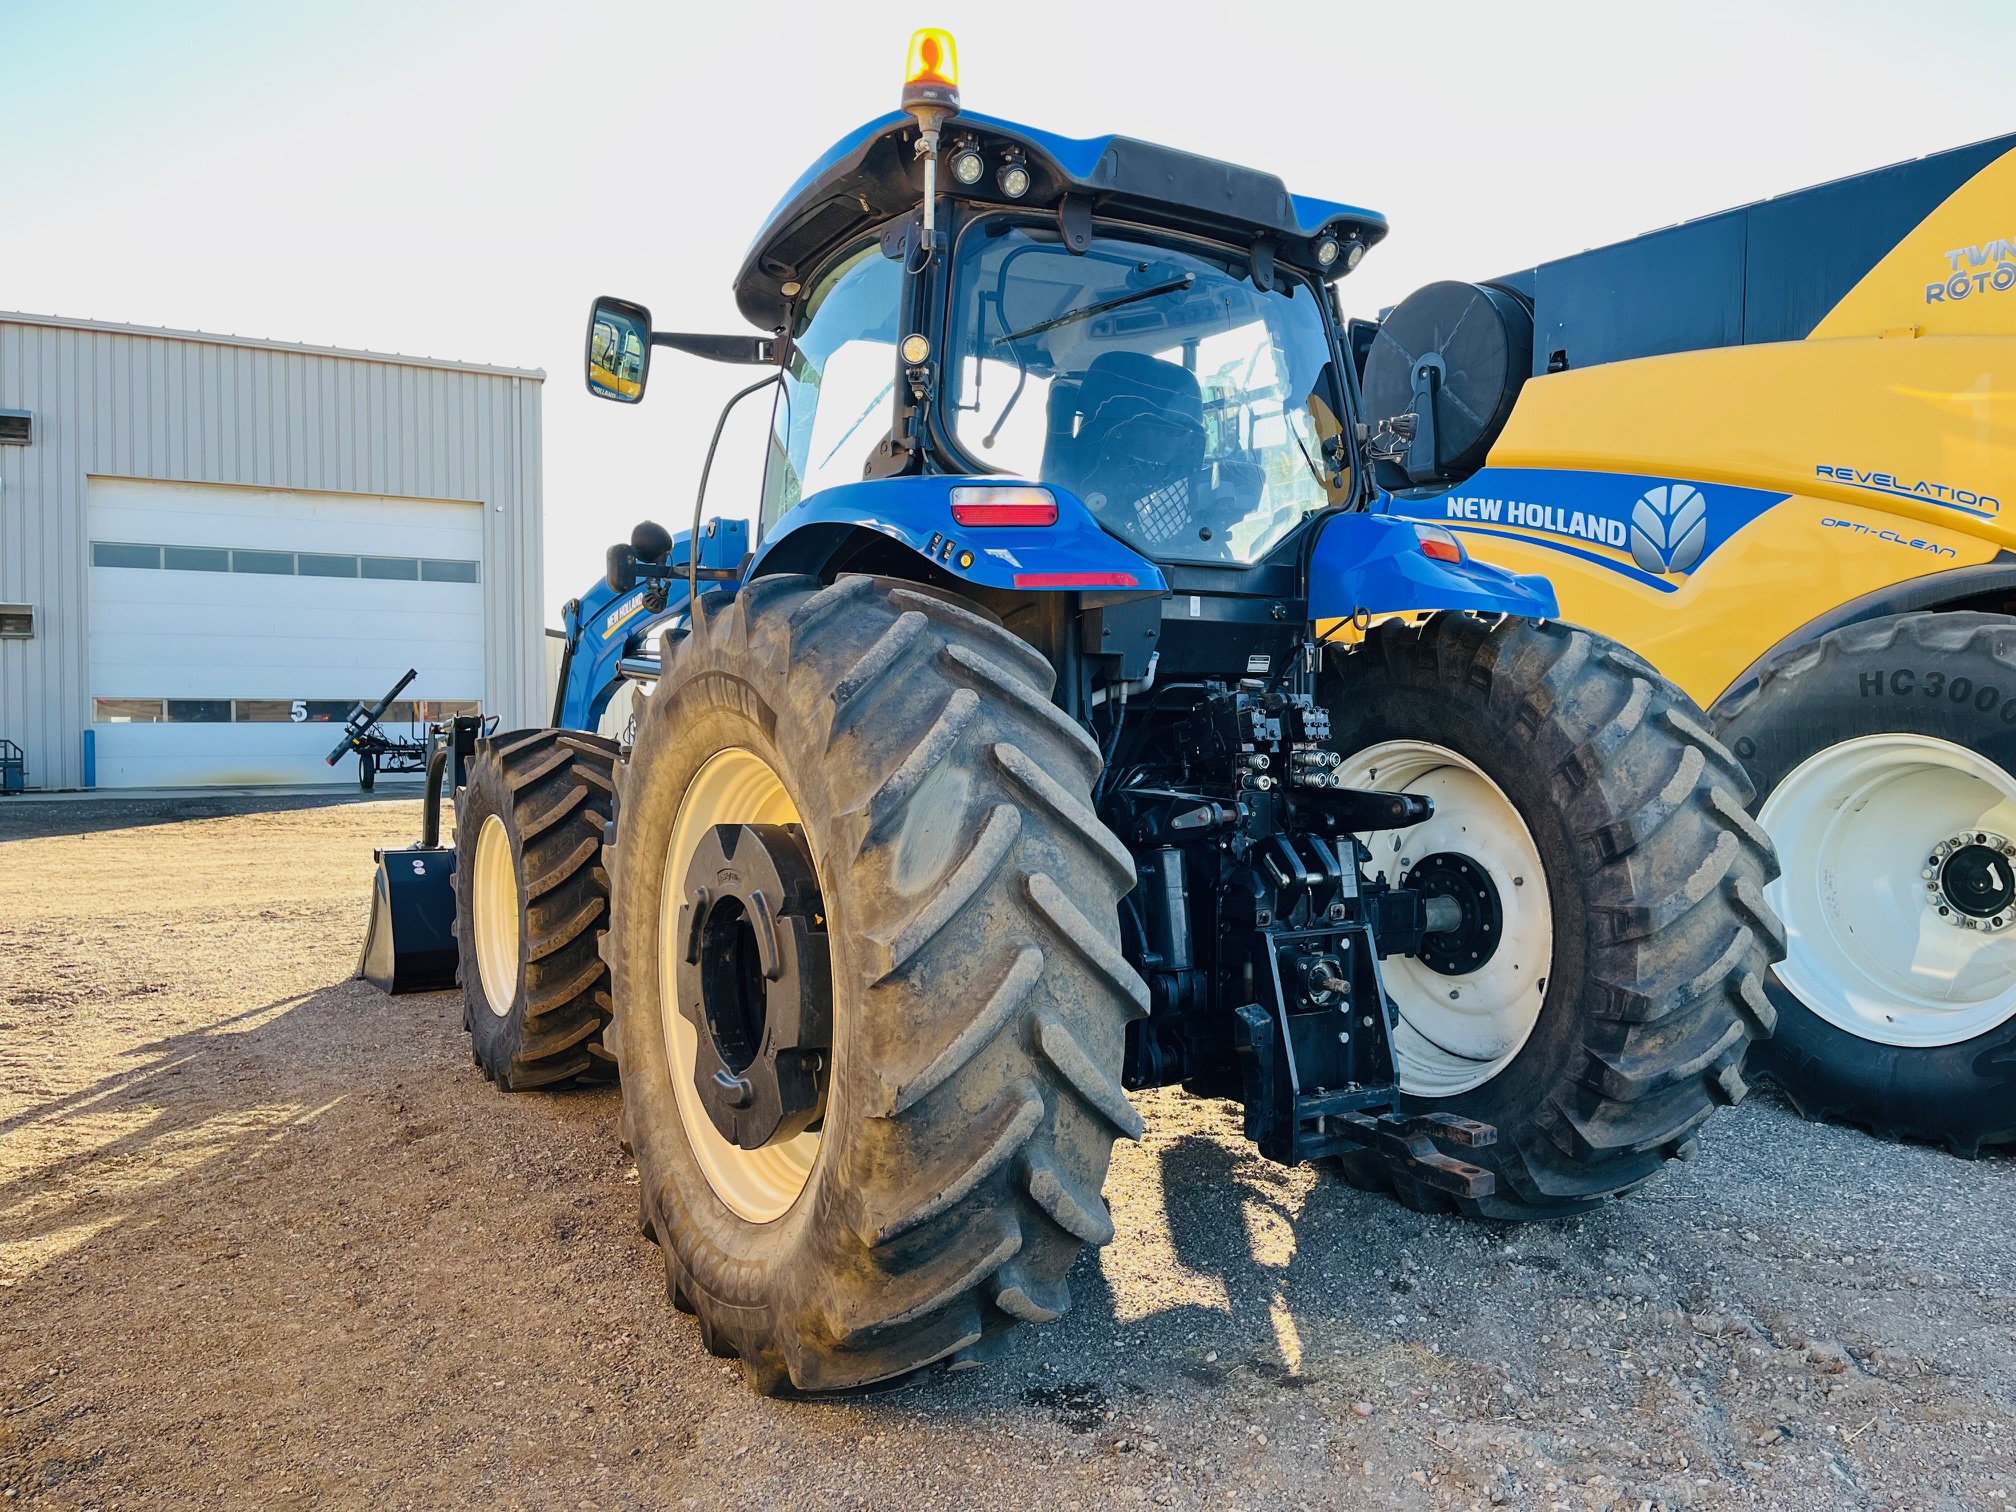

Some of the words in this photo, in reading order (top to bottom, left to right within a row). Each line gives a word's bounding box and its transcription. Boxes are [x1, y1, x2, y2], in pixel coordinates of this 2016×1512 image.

[1945, 236, 2016, 271] TWIN
[1816, 465, 1999, 512] REVELATION
[1446, 496, 1503, 521] NEW
[1507, 500, 1627, 547] HOLLAND
[1820, 517, 1956, 558] OPTI-CLEAN
[606, 609, 619, 630] NEW
[291, 700, 308, 723] 5
